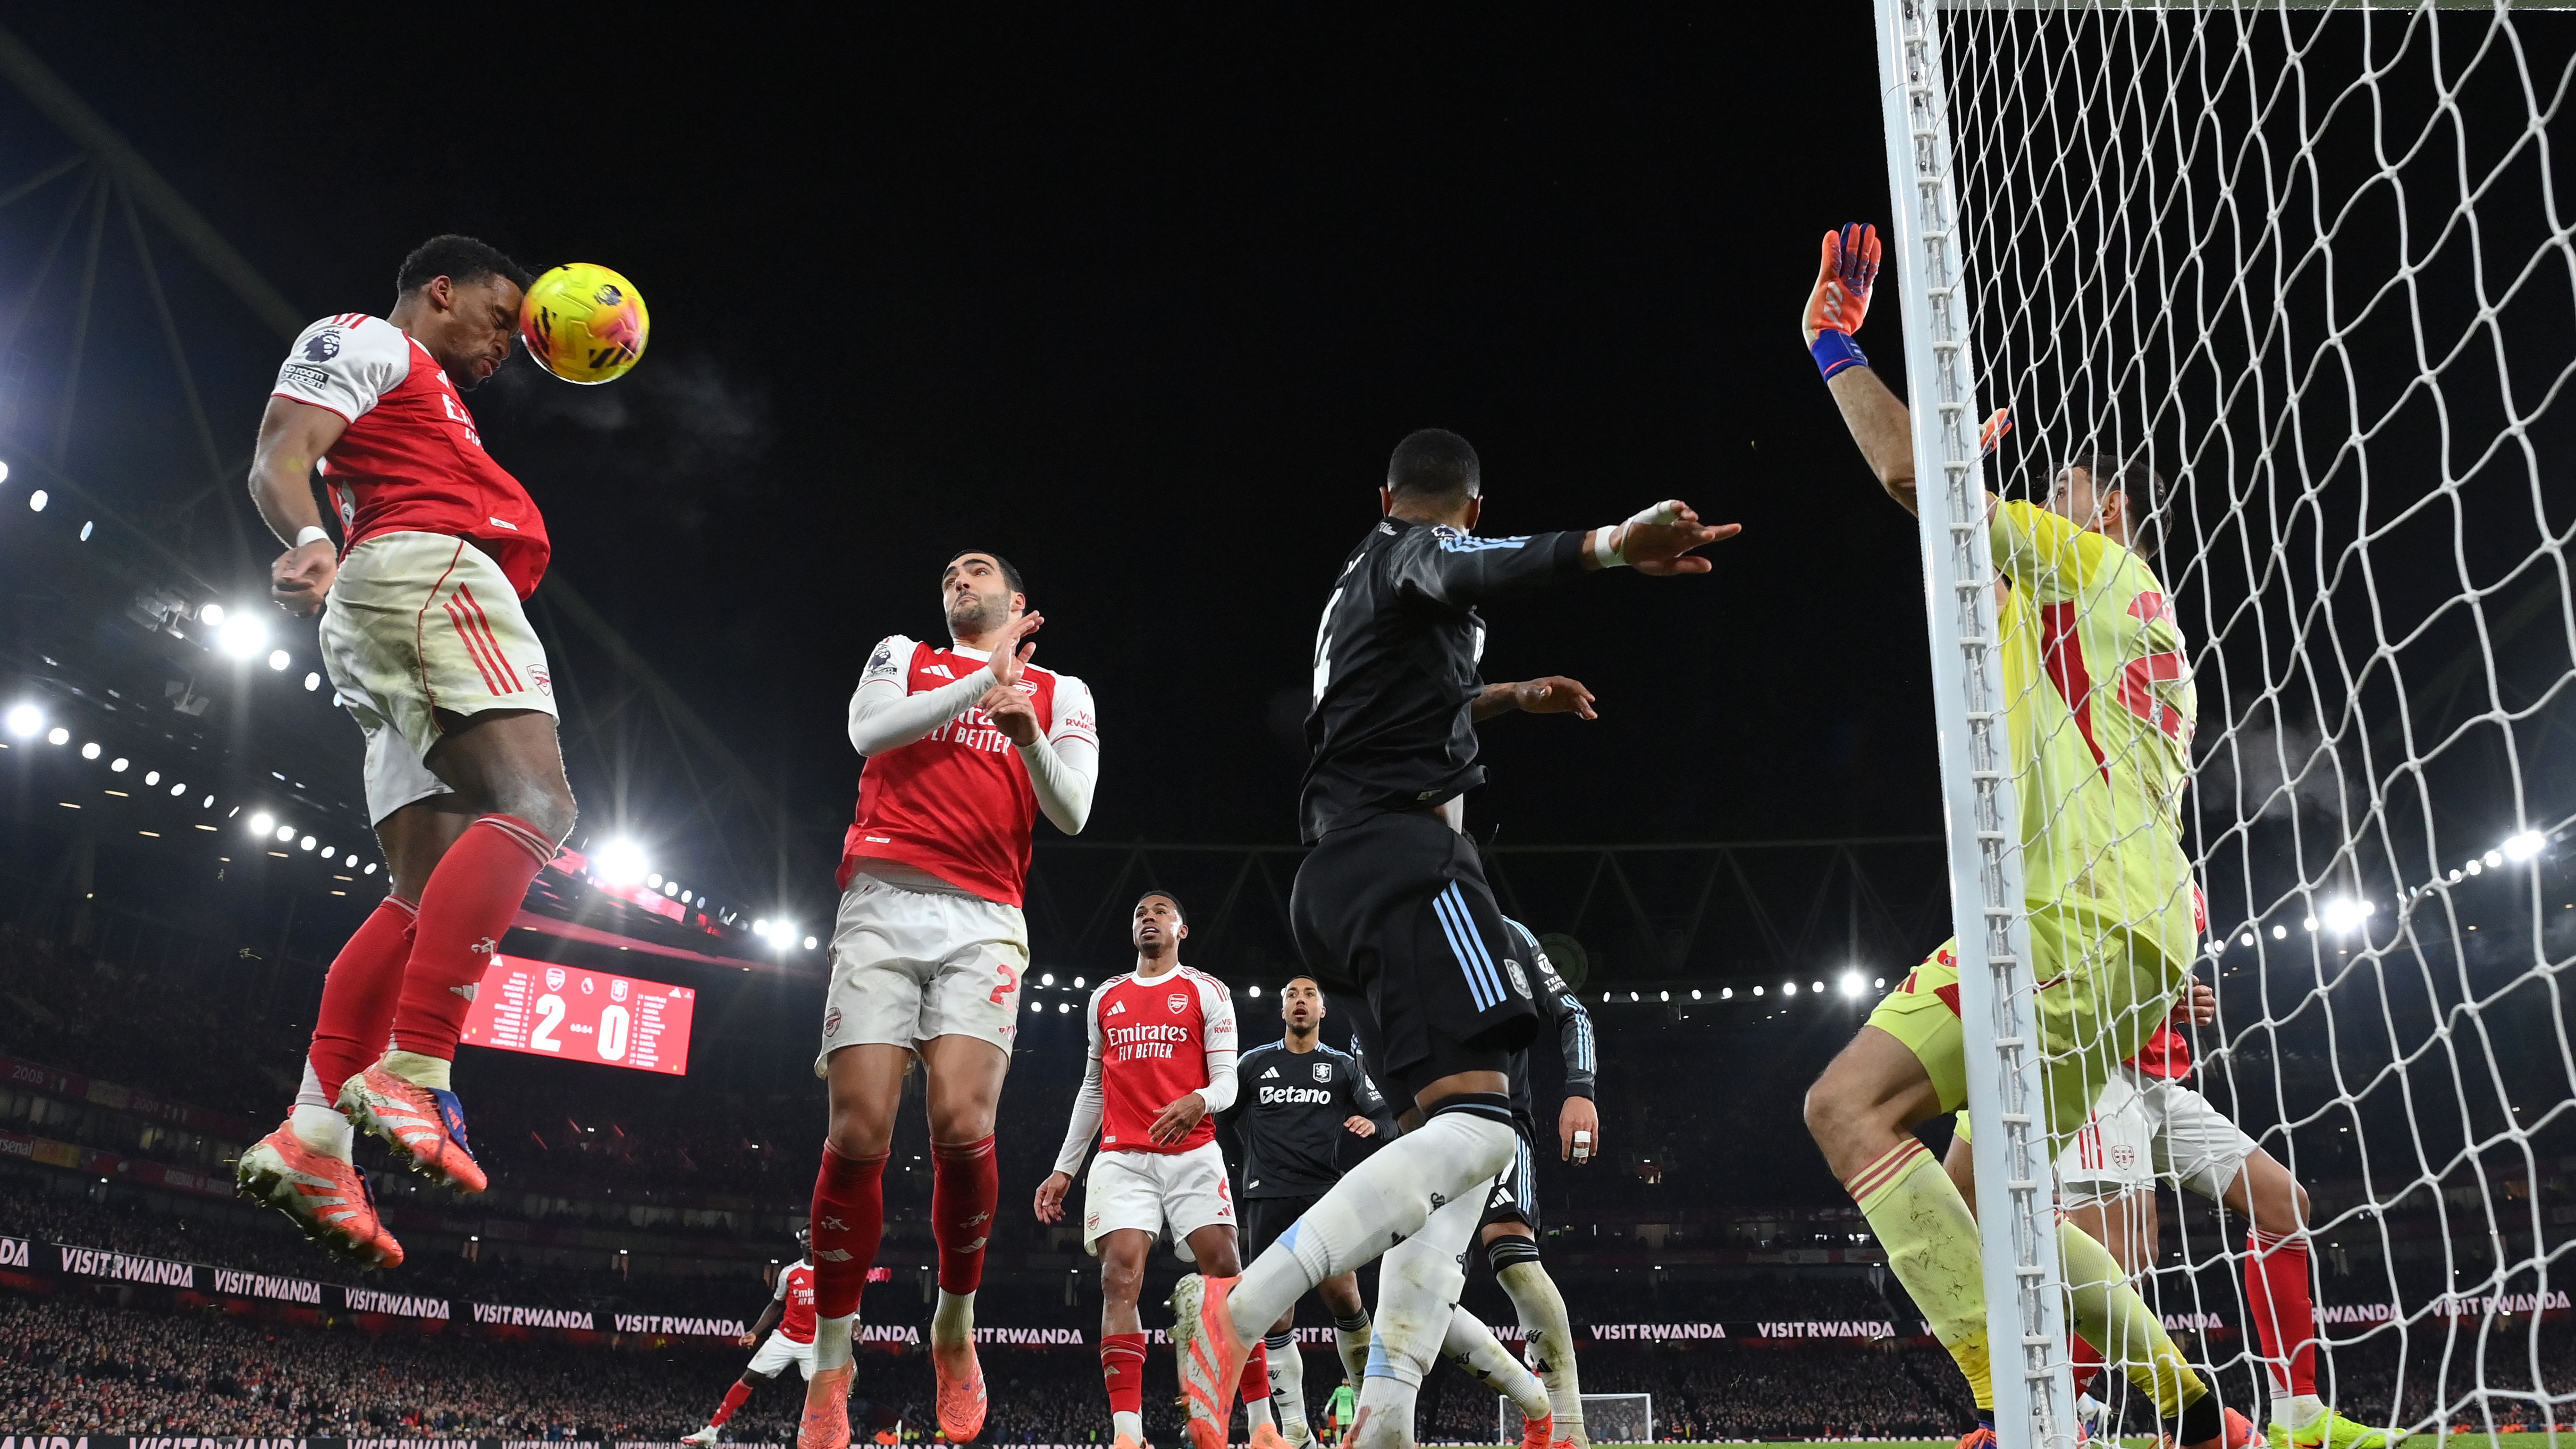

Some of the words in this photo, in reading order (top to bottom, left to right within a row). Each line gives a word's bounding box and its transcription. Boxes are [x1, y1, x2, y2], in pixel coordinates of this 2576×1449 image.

[922, 720, 954, 742] LY
[954, 726, 1012, 756] BETTER
[531, 993, 566, 1052] 2
[597, 1004, 630, 1061] 0
[1107, 1022, 1188, 1047] Emirates
[1118, 1044, 1133, 1062] FLY
[1135, 1042, 1174, 1059] BETTER
[1259, 1085, 1331, 1105] Betano
